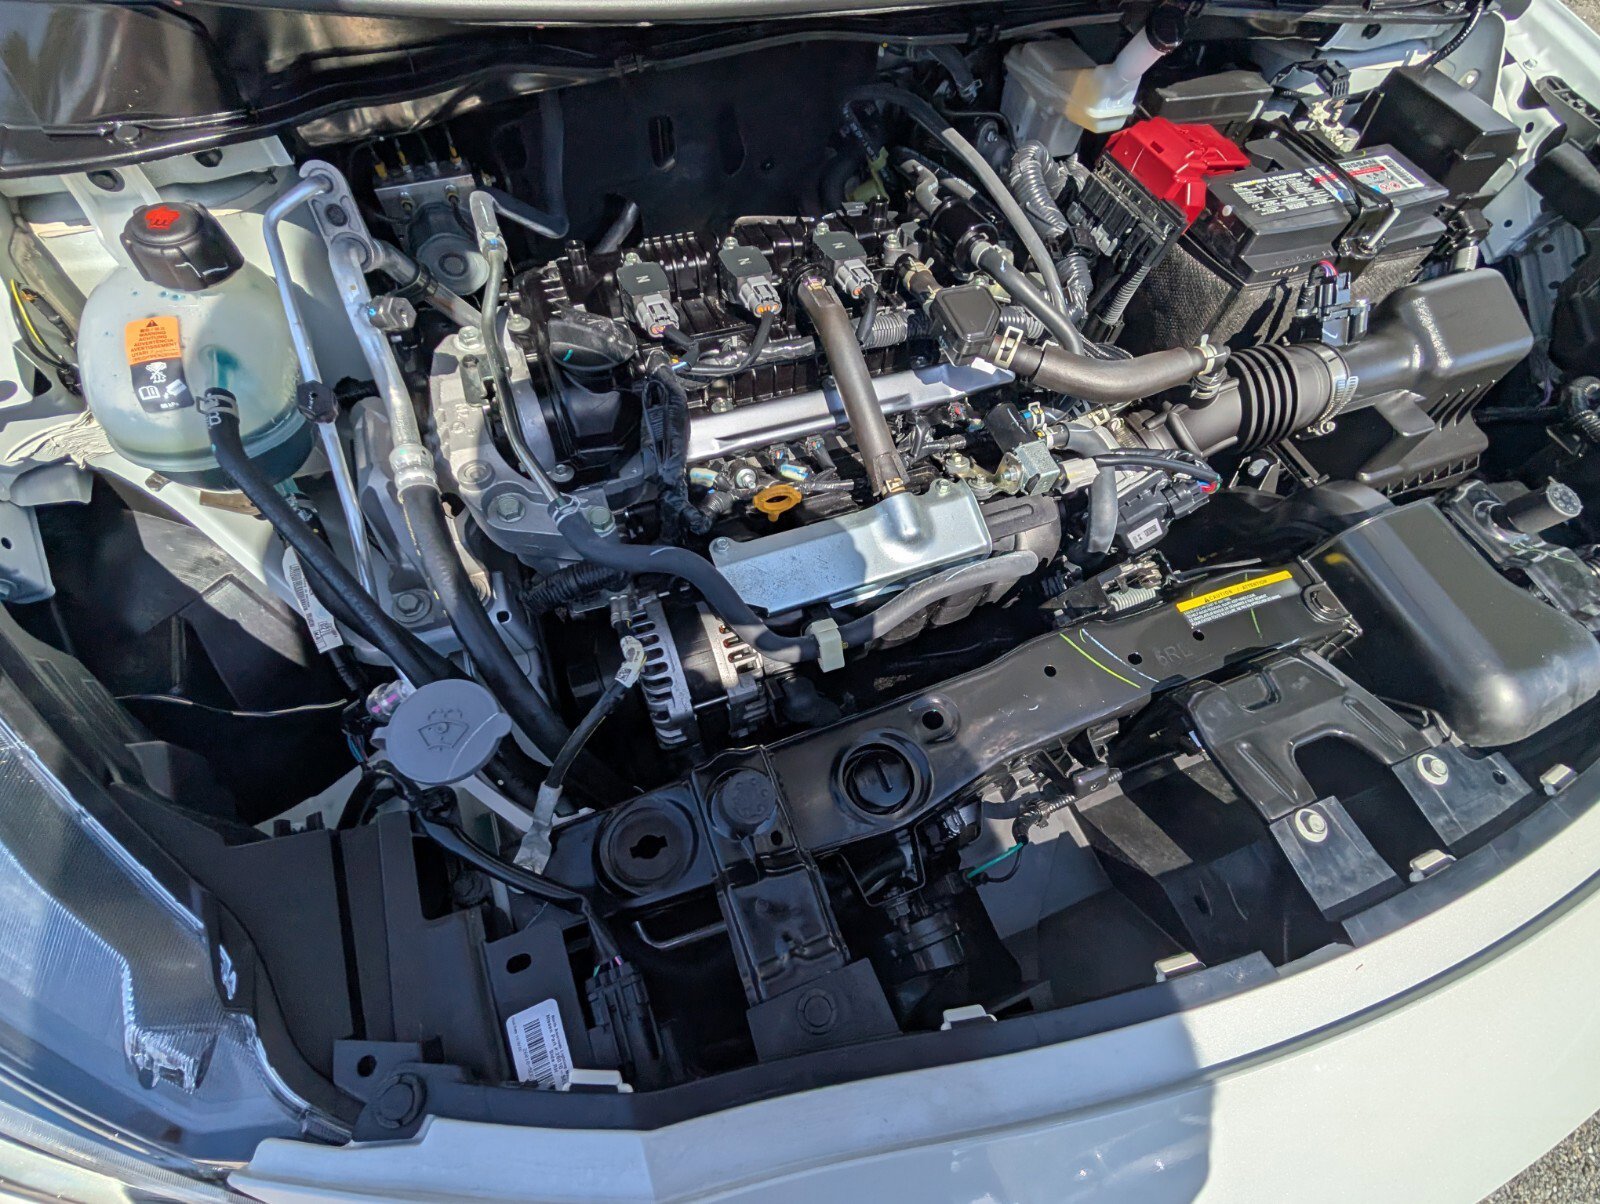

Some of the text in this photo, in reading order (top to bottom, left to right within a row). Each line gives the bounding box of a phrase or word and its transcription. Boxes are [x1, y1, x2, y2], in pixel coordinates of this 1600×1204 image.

[1341, 158, 1377, 169] NISSAN
[131, 342, 177, 352] AVERTISSEMENT
[1209, 589, 1232, 600] CAUTION
[1242, 579, 1267, 590] ATTENTION
